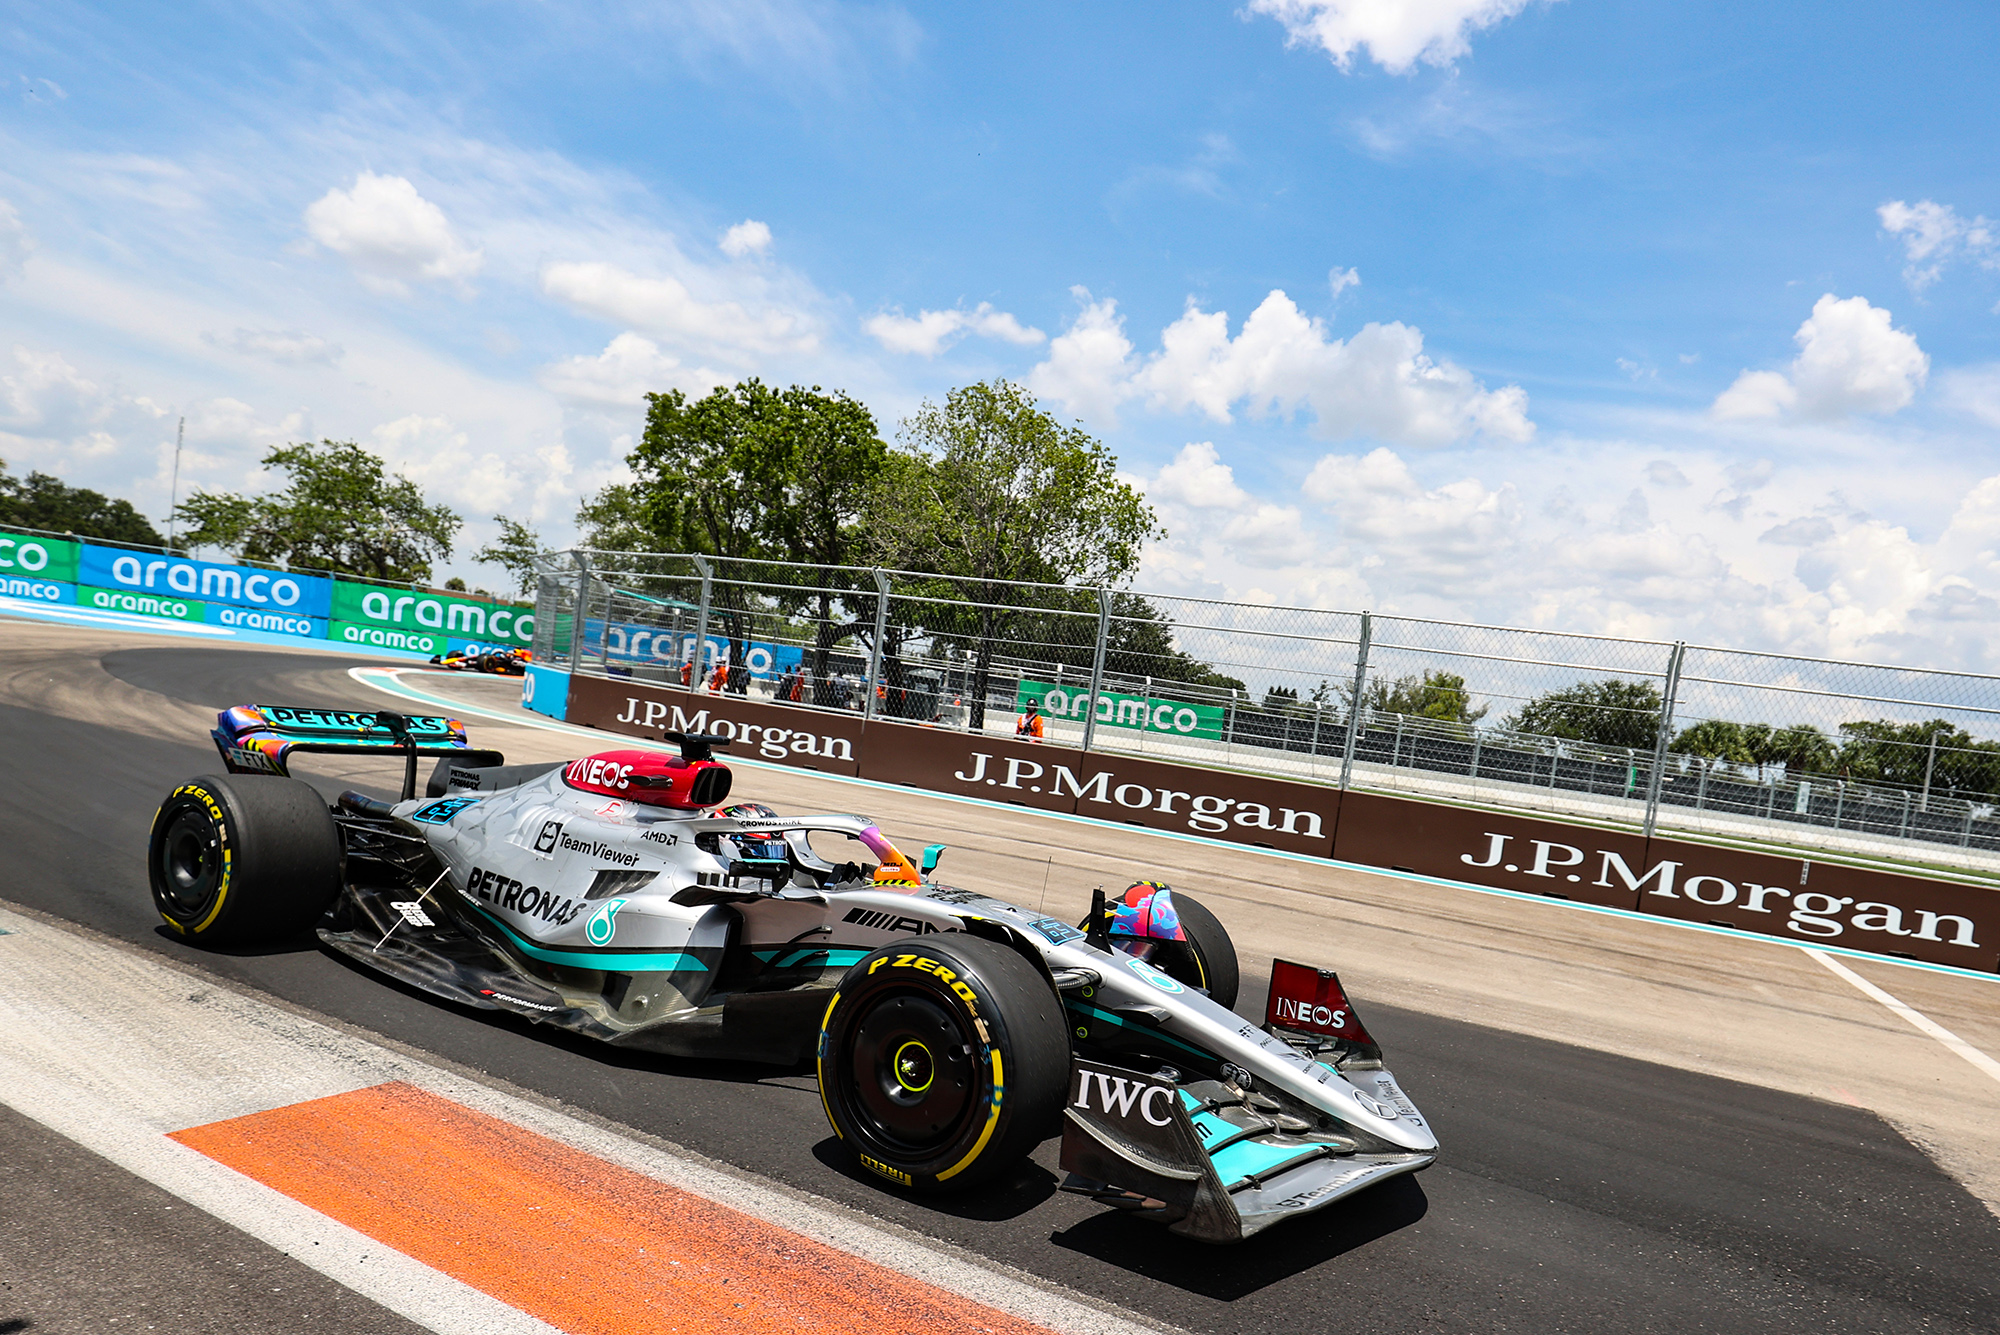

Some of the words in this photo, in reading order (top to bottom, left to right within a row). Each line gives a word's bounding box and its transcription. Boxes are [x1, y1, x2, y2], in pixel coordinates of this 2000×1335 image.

[112, 556, 300, 606] aramco
[94, 592, 188, 617] aramco
[362, 592, 535, 641] aramco
[220, 609, 311, 635] aramco
[344, 626, 434, 652] aramco
[272, 708, 441, 731] PETROAS
[1044, 689, 1197, 732] aramco
[616, 698, 854, 761] J.P.Morgan
[243, 750, 271, 770] FTX
[451, 769, 480, 781] PETRONAS
[567, 759, 634, 790] INEOS
[449, 778, 481, 791] PRIMAX
[954, 752, 1326, 839] J.P.Morgan
[184, 785, 223, 820] ZERO
[558, 832, 640, 867] TeamViewer
[640, 830, 668, 843] AMD
[467, 867, 587, 925] PETRONAS
[1461, 832, 1980, 948] J.P.Morgan
[868, 956, 889, 975] P
[891, 954, 977, 1003] ZERO
[492, 993, 557, 1012] PERFORMANCE
[1275, 996, 1346, 1029] INEOS
[1073, 1069, 1177, 1127] IWC
[860, 1153, 912, 1187] PIRELLI
